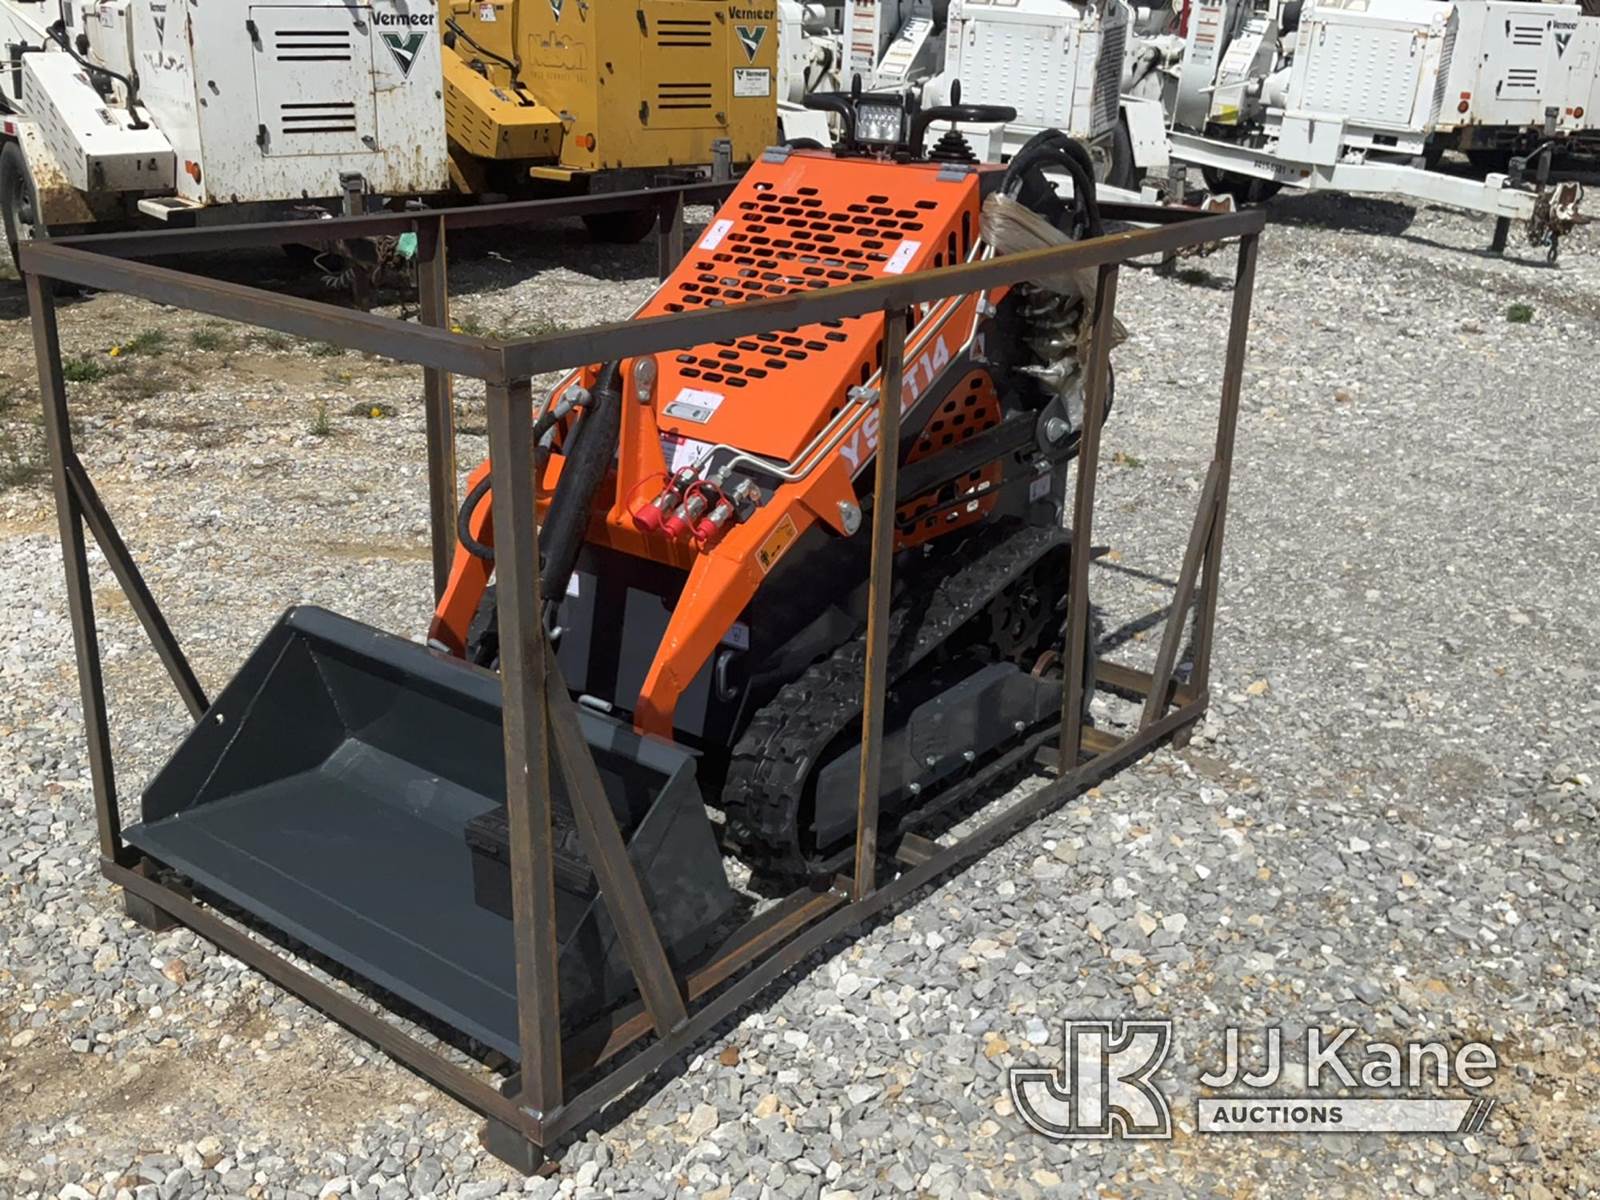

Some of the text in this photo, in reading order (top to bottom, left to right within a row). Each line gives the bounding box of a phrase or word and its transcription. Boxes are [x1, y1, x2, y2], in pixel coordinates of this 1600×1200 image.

[372, 11, 434, 26] Vermeer
[729, 6, 774, 20] Vermeer
[840, 334, 949, 471] YST14
